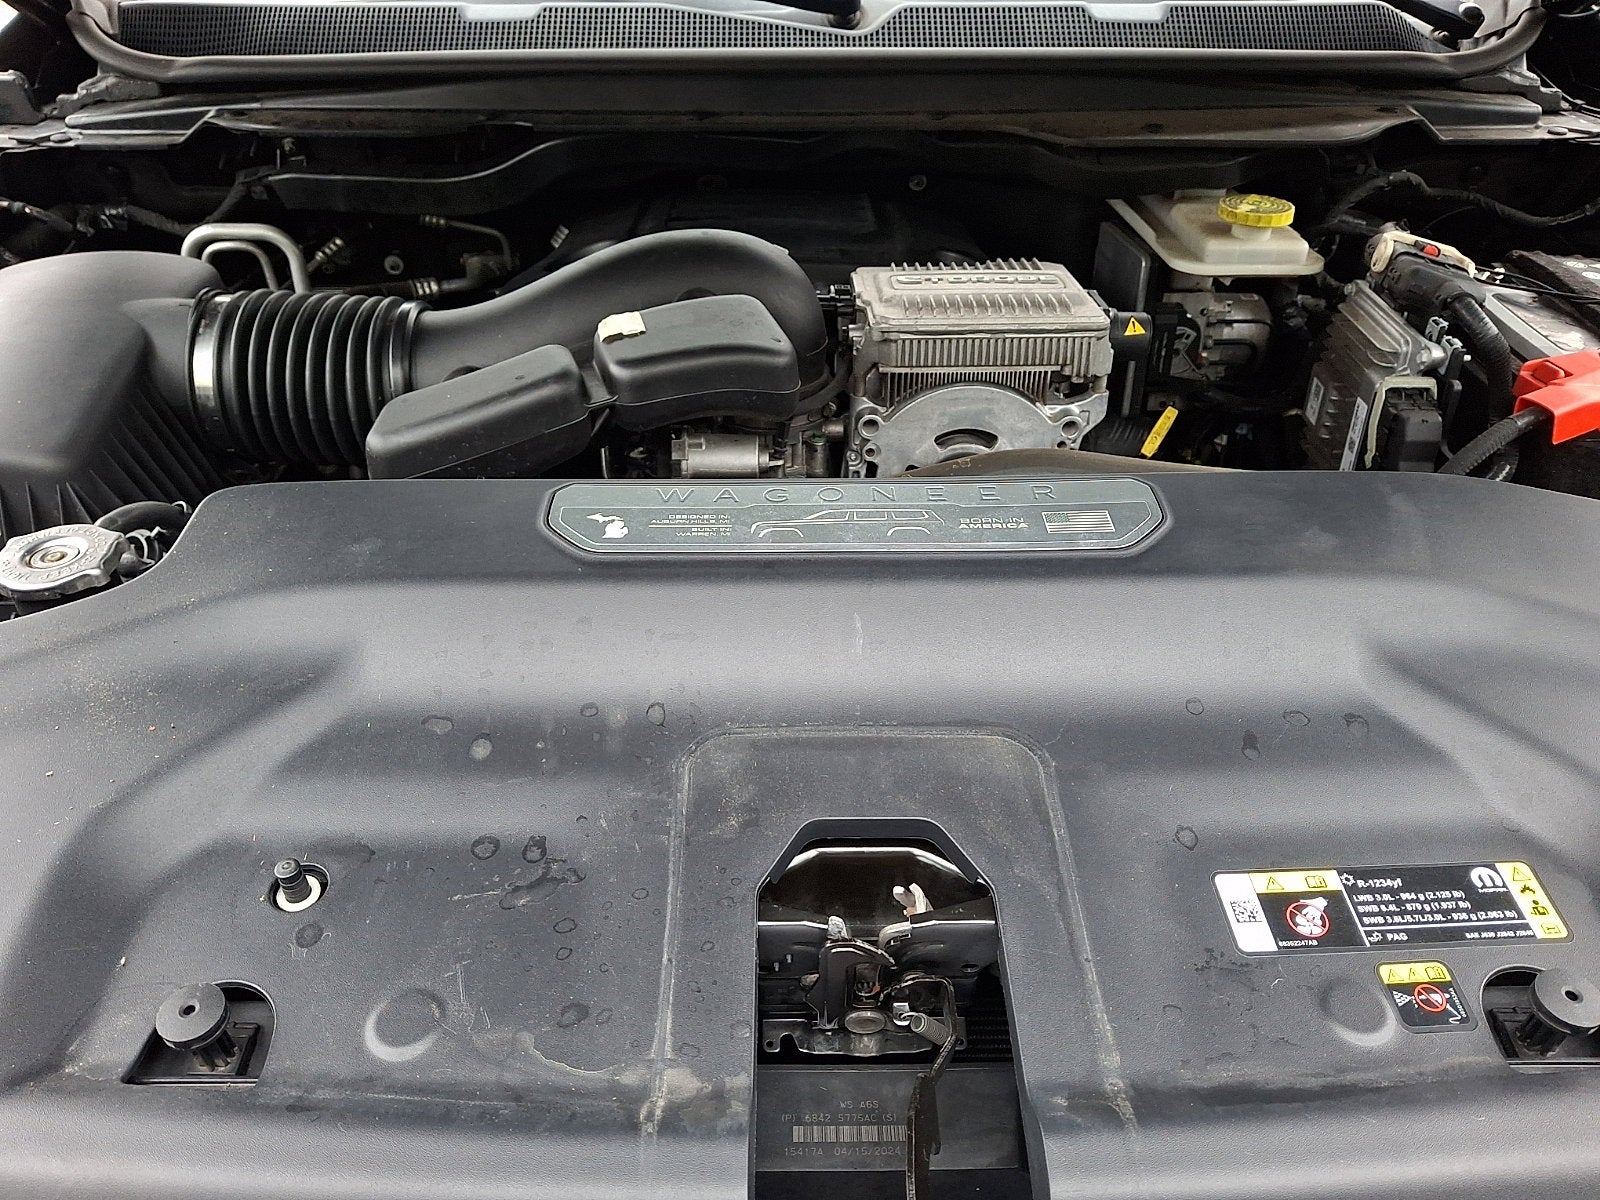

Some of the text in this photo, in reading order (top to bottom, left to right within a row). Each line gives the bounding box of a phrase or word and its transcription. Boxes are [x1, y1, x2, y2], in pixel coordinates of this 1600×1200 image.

[656, 485, 1057, 503] WAGONEER
[1357, 878, 1402, 888] R-1234yf
[1353, 894, 1374, 902] LWB
[1376, 893, 1395, 901] 3.0L
[1387, 932, 1408, 941] PAG
[839, 1100, 853, 1109] WS
[781, 1113, 897, 1123] (P) 6842 5775AC (S)
